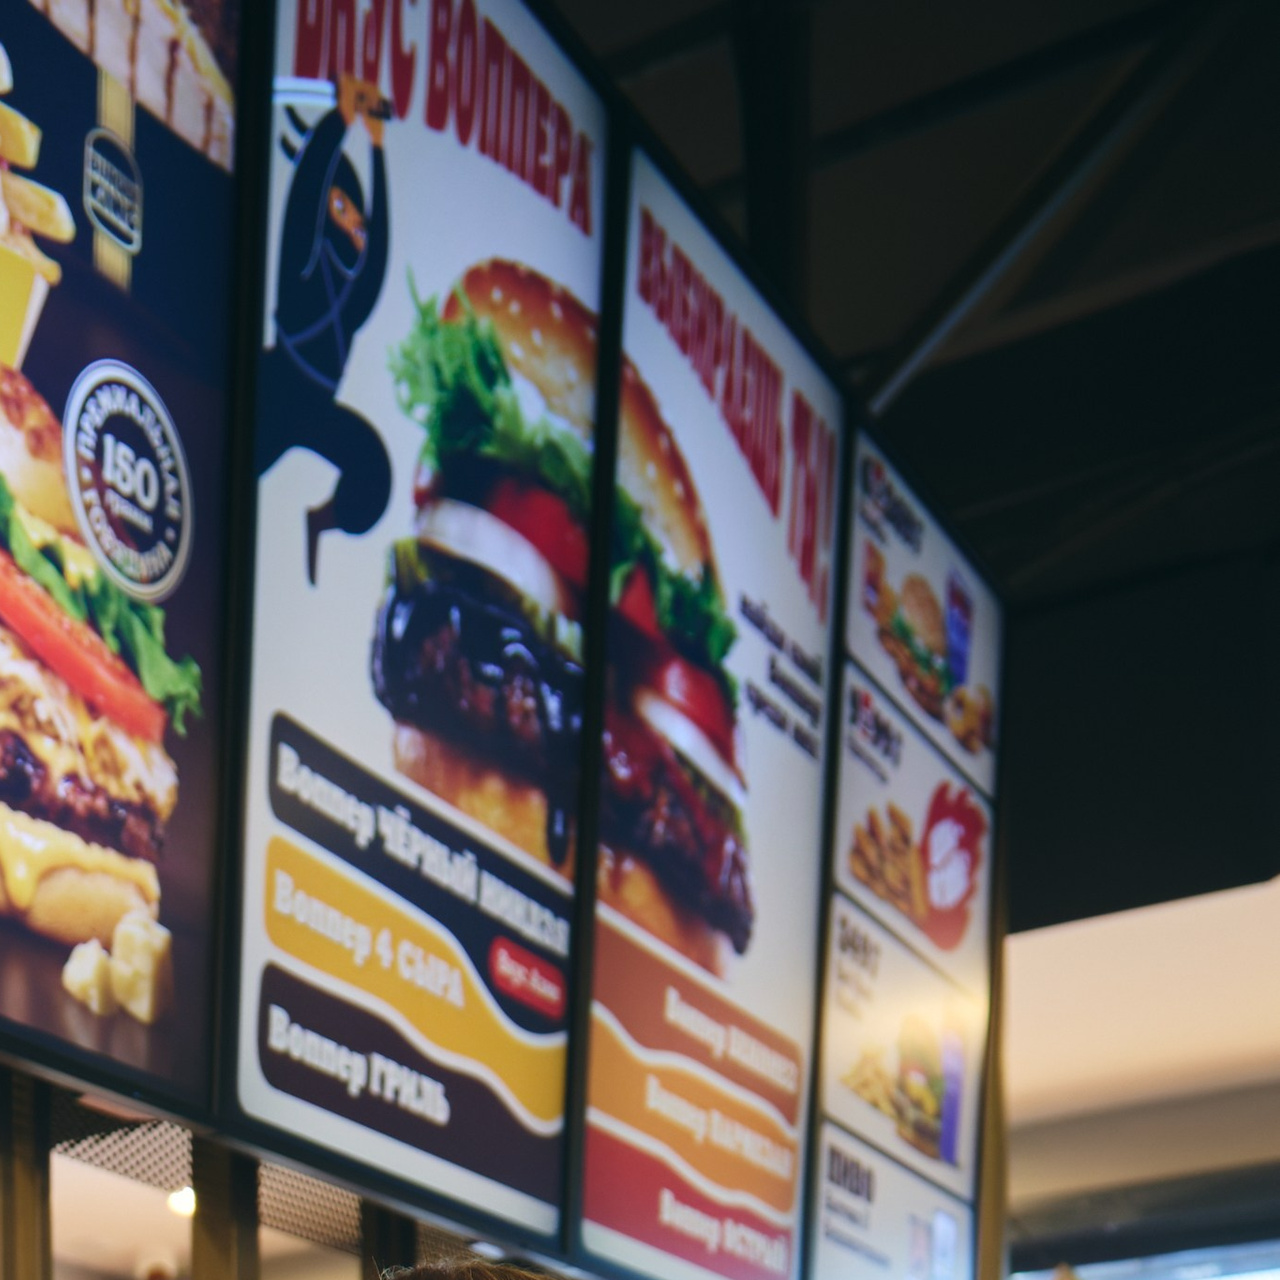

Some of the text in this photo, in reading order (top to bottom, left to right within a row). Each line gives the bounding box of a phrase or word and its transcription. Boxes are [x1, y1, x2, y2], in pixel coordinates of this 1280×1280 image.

[102, 433, 159, 512] 150
[277, 741, 376, 850] Воппер
[274, 868, 372, 968] Воппер
[375, 927, 394, 970] 4
[268, 1003, 368, 1097] Воппер
